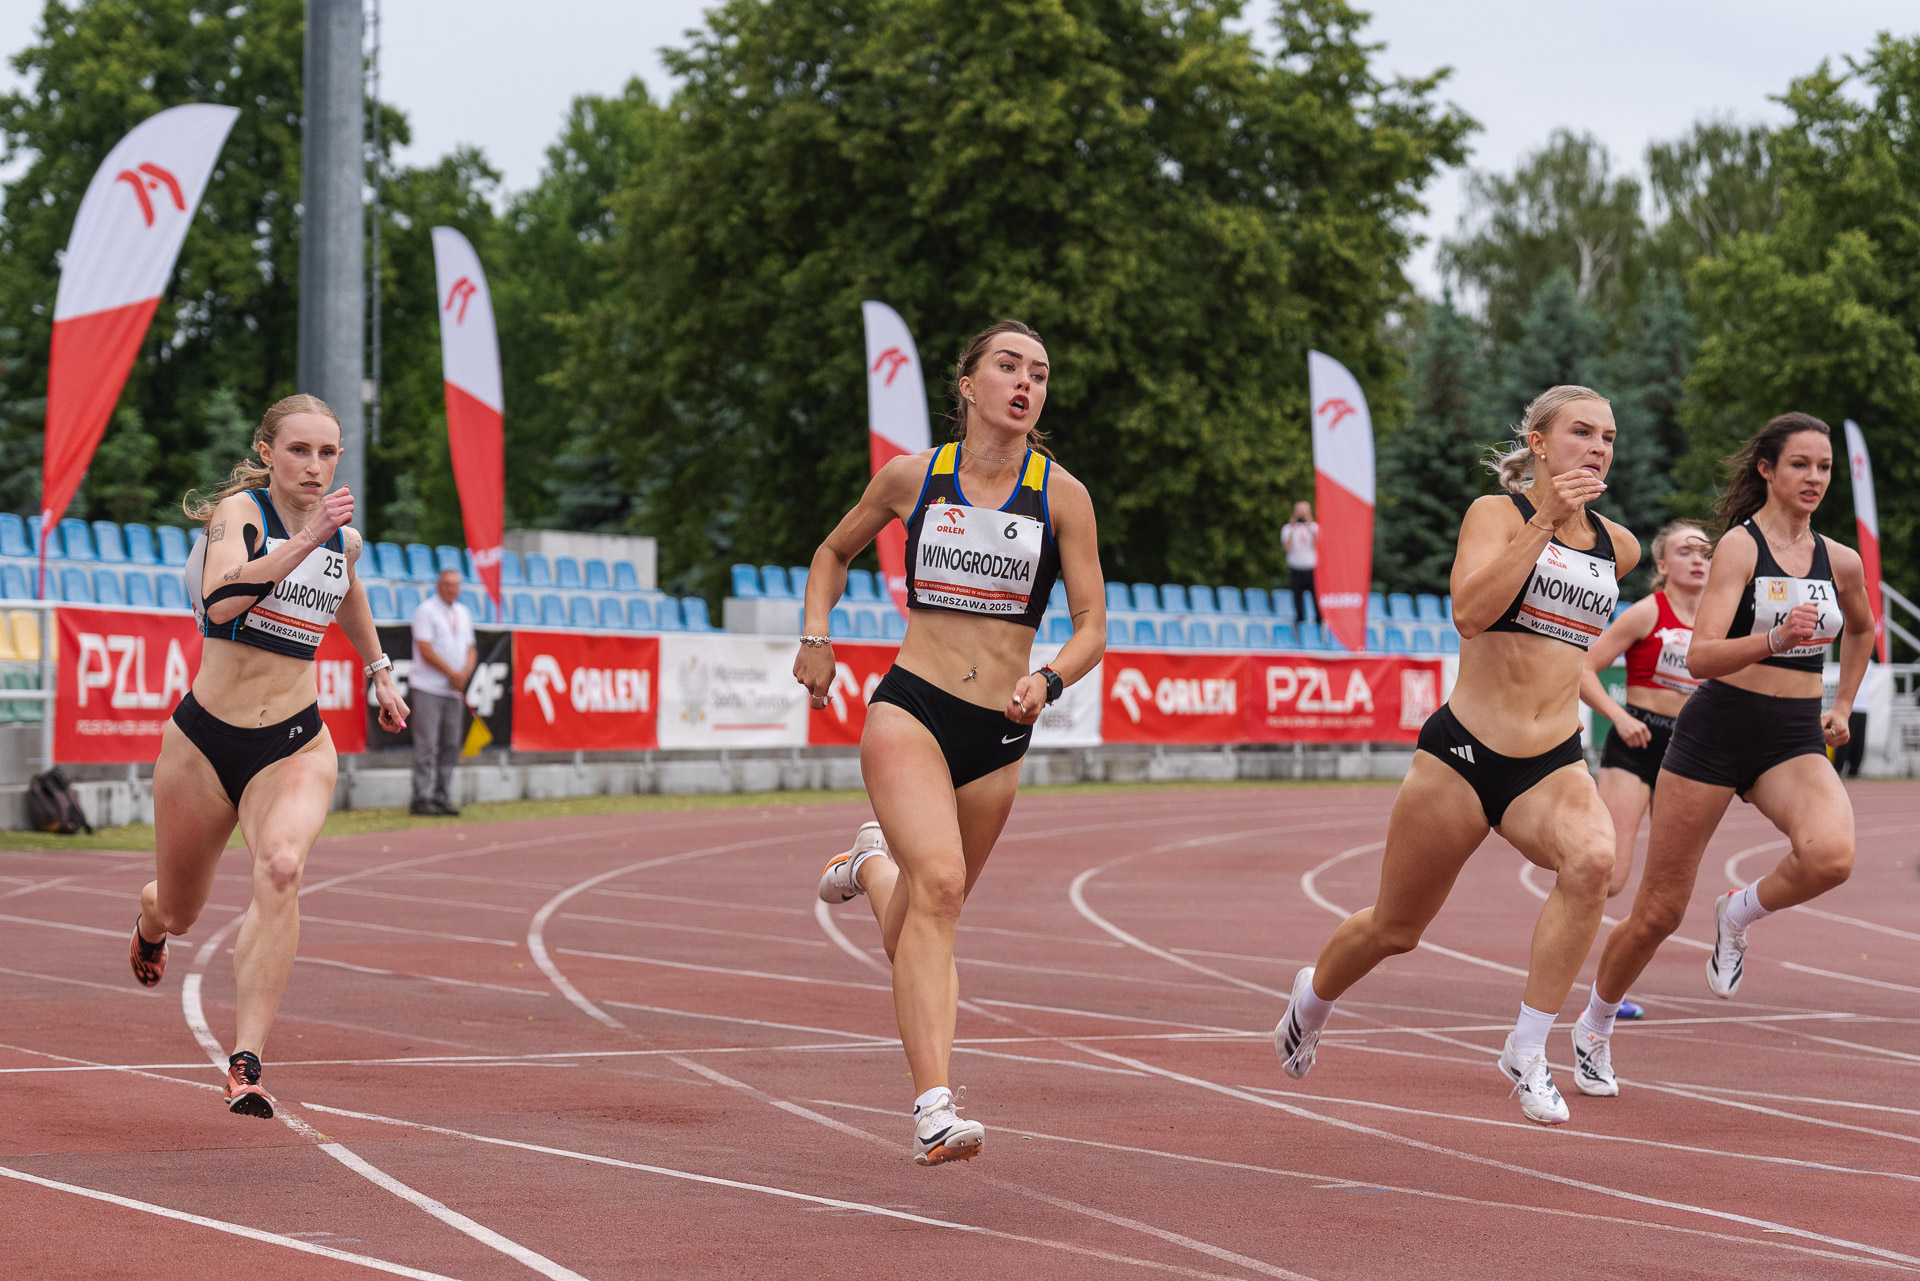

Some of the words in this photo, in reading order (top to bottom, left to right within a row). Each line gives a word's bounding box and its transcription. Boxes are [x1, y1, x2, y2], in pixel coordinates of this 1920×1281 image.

[936, 525, 965, 536] ORLEN
[1003, 521, 1018, 540] 6
[323, 555, 344, 579] 25
[922, 543, 1030, 582] WINOGRODZKA
[1589, 562, 1600, 578] 5
[268, 580, 343, 615] UJAROWICZ
[956, 586, 970, 594] Polski
[1532, 574, 1613, 617] NOWICKA
[1807, 584, 1829, 601] 21
[928, 594, 987, 611] WARSZAWA
[989, 603, 1012, 612] 2025
[260, 620, 310, 642] WARSZAWA
[1531, 620, 1573, 640] WARSZAWA
[1574, 633, 1590, 644] 2025
[77, 632, 189, 709] PZLA
[570, 666, 650, 713] ORLEN
[1155, 678, 1237, 716] ORLEN
[1266, 666, 1375, 713] PZLA
